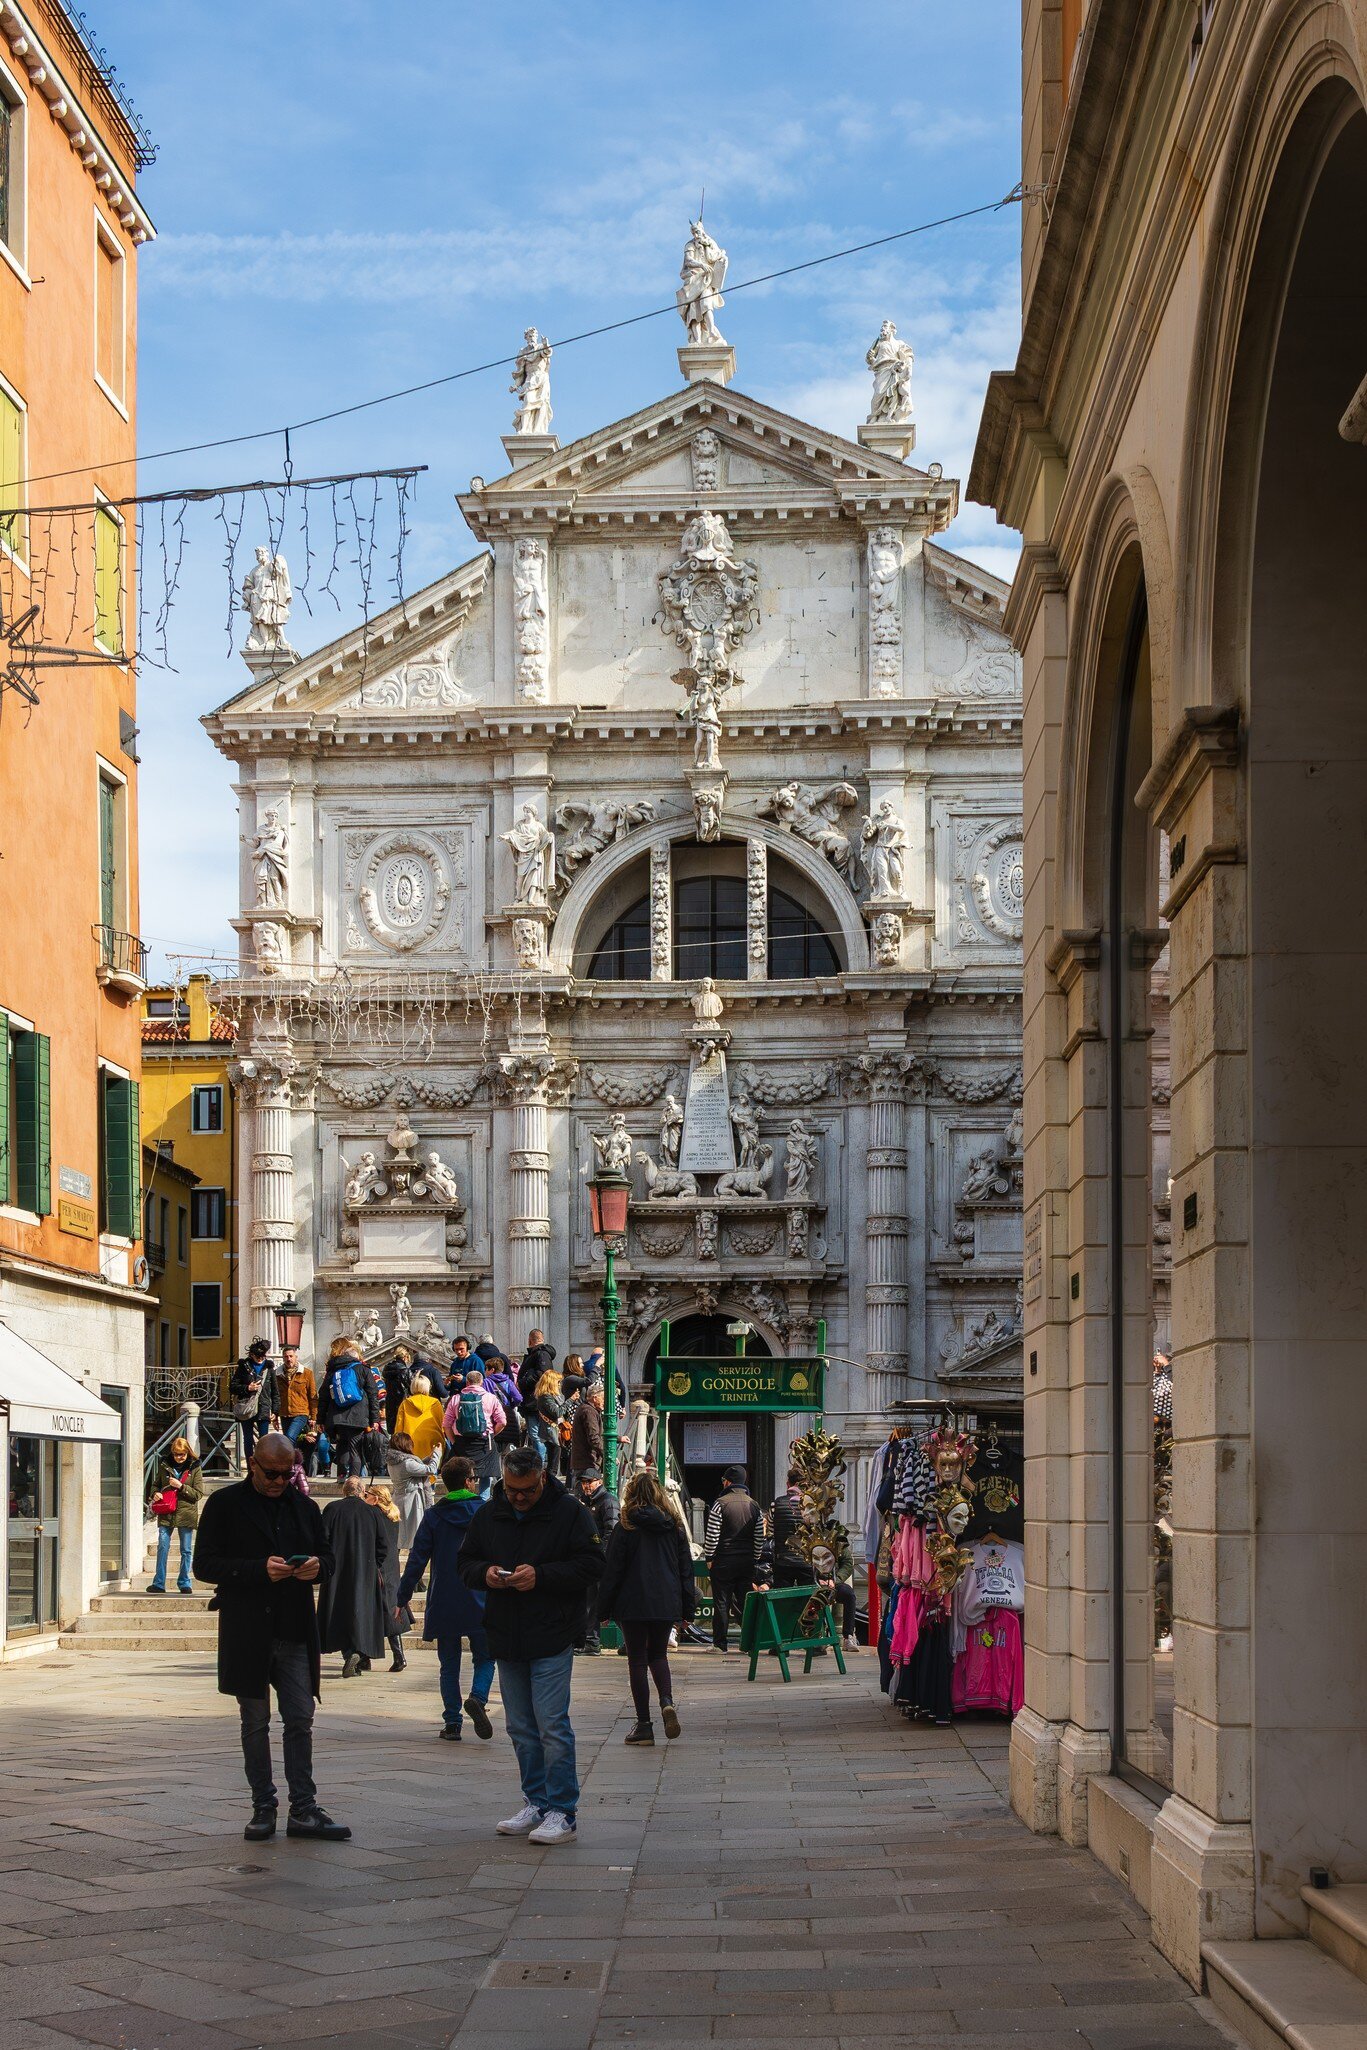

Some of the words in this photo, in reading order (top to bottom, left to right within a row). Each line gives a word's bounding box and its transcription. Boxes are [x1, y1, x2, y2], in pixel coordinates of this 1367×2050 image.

[718, 1366, 761, 1375] SERVIZIO
[702, 1378, 776, 1390] GONDOLE
[720, 1392, 759, 1402] TRINITÀ
[51, 1414, 85, 1433] MONCLER
[974, 1566, 1015, 1585] ITALIA
[980, 1596, 1013, 1606] VENEZIA
[973, 1626, 1007, 1648] ITIA
